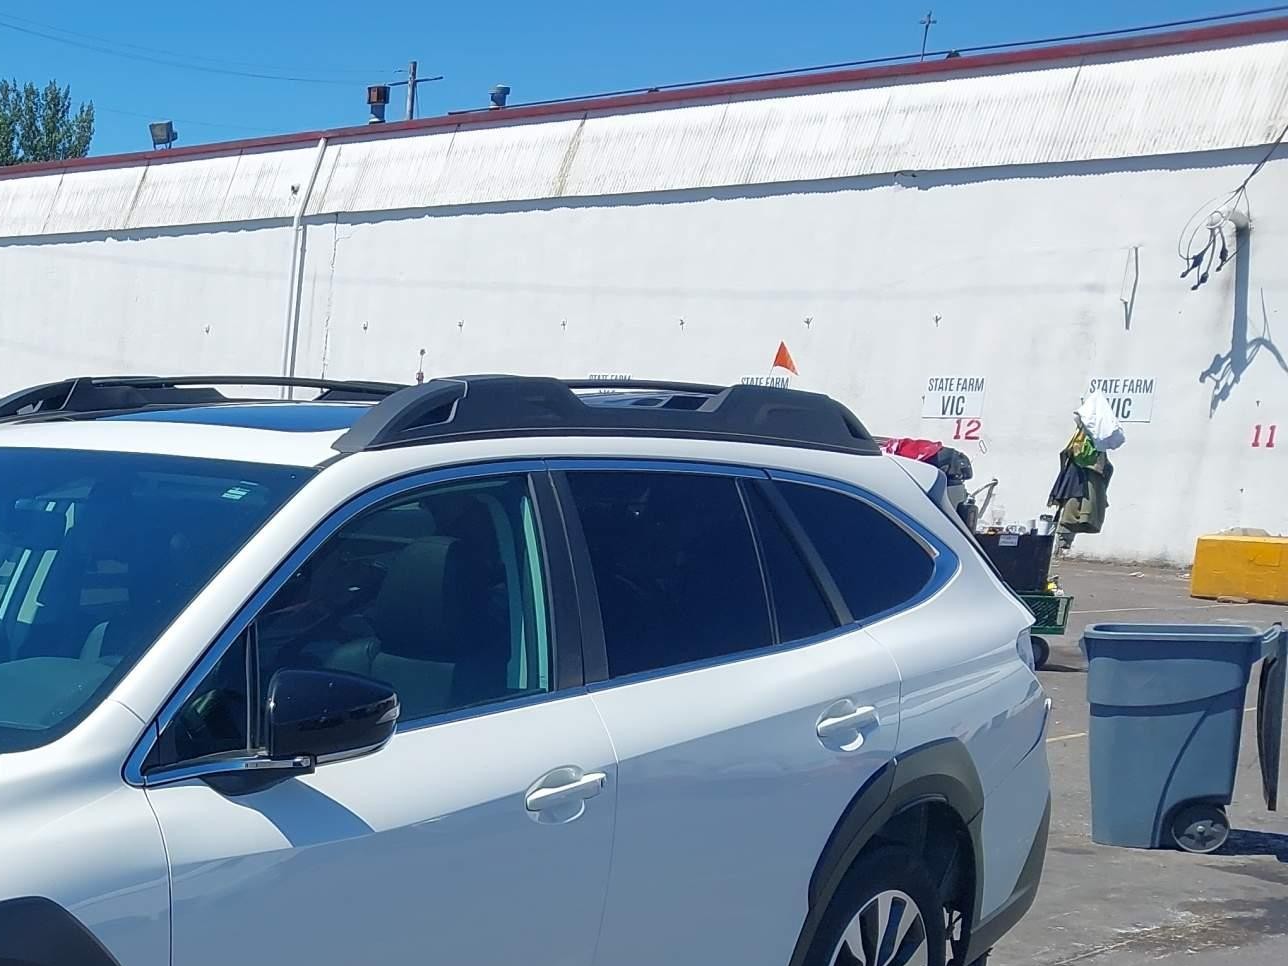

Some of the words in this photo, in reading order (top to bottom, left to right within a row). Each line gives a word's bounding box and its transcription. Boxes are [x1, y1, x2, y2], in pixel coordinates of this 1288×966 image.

[928, 378, 954, 391] STATE
[956, 378, 984, 392] FARM
[1089, 379, 1120, 393] STATE
[1122, 379, 1154, 394] FARM
[941, 396, 965, 416] VIC
[953, 418, 981, 440] 12
[1252, 424, 1276, 447] 11
